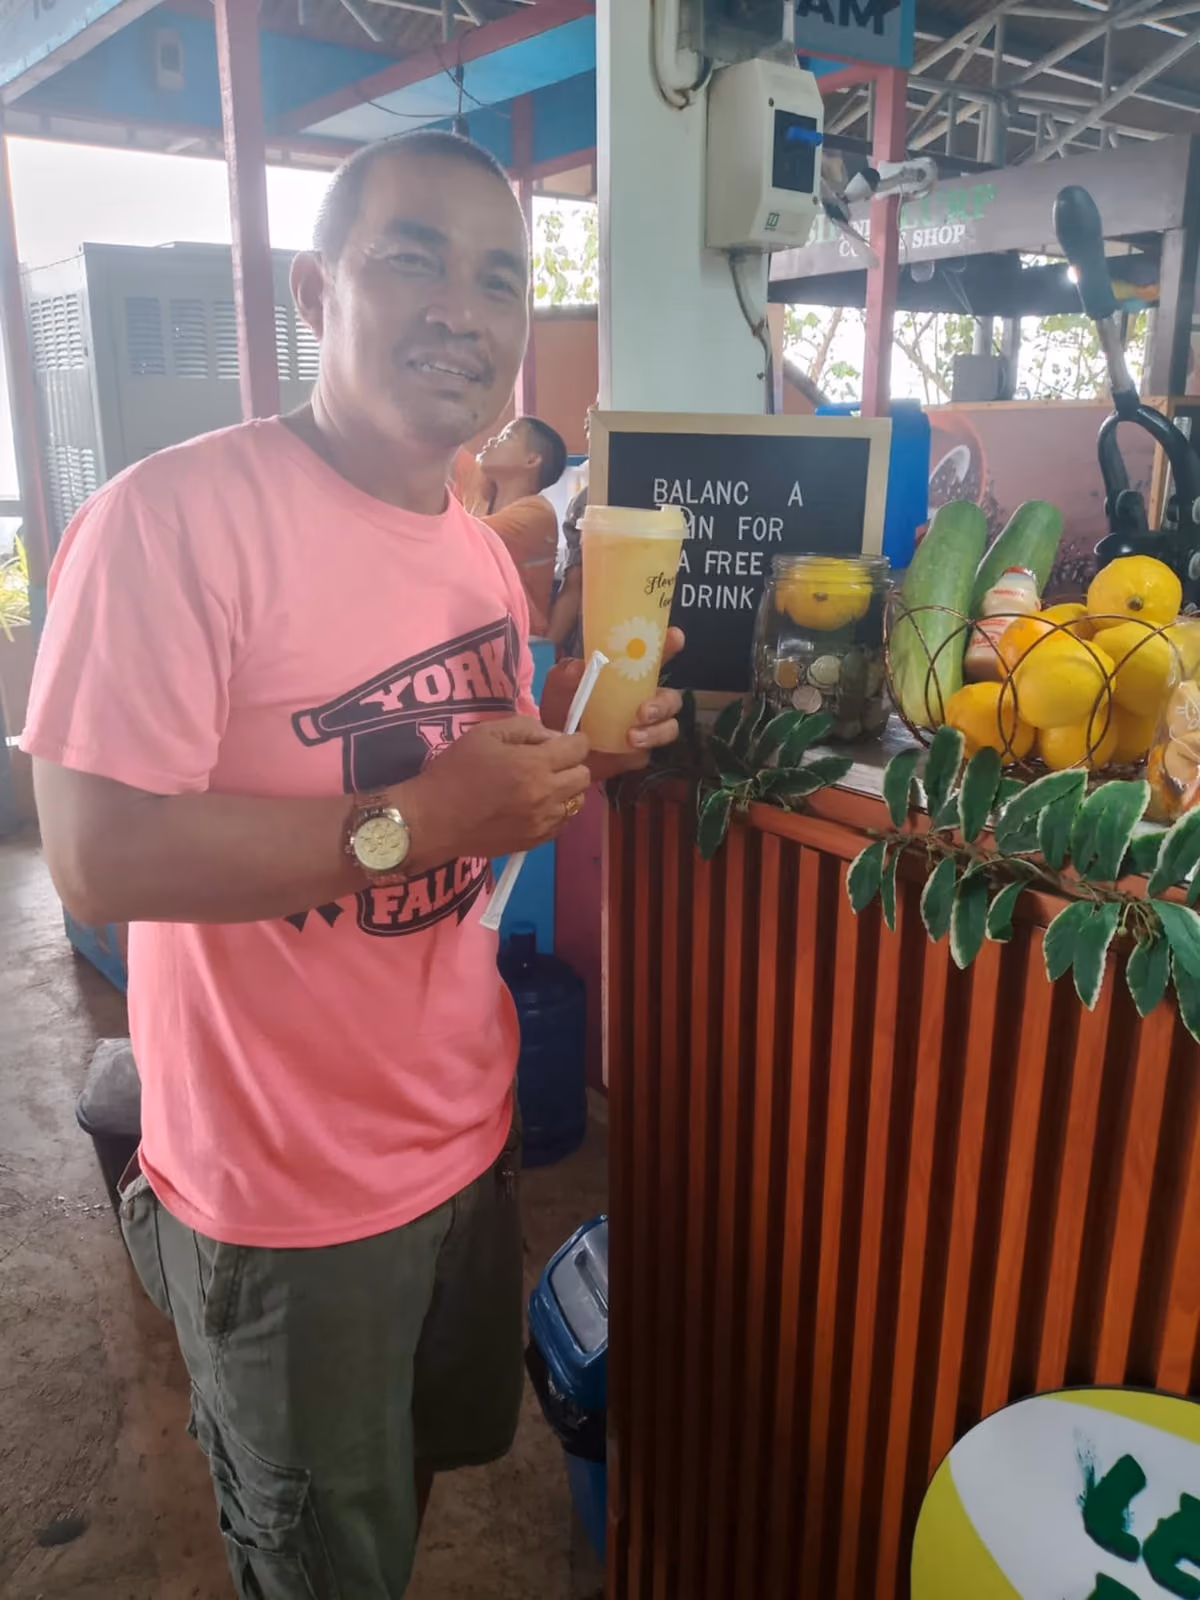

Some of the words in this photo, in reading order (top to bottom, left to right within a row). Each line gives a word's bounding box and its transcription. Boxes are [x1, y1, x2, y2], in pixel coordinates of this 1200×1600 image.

[912, 224, 966, 249] SHOP
[653, 477, 749, 506] BALANC
[787, 480, 804, 507] A
[738, 516, 784, 542] FOR
[676, 550, 691, 574] A
[704, 550, 764, 576] FREE
[681, 583, 755, 610] DRINK
[359, 634, 515, 712] YORK
[370, 856, 488, 925] FALCO
